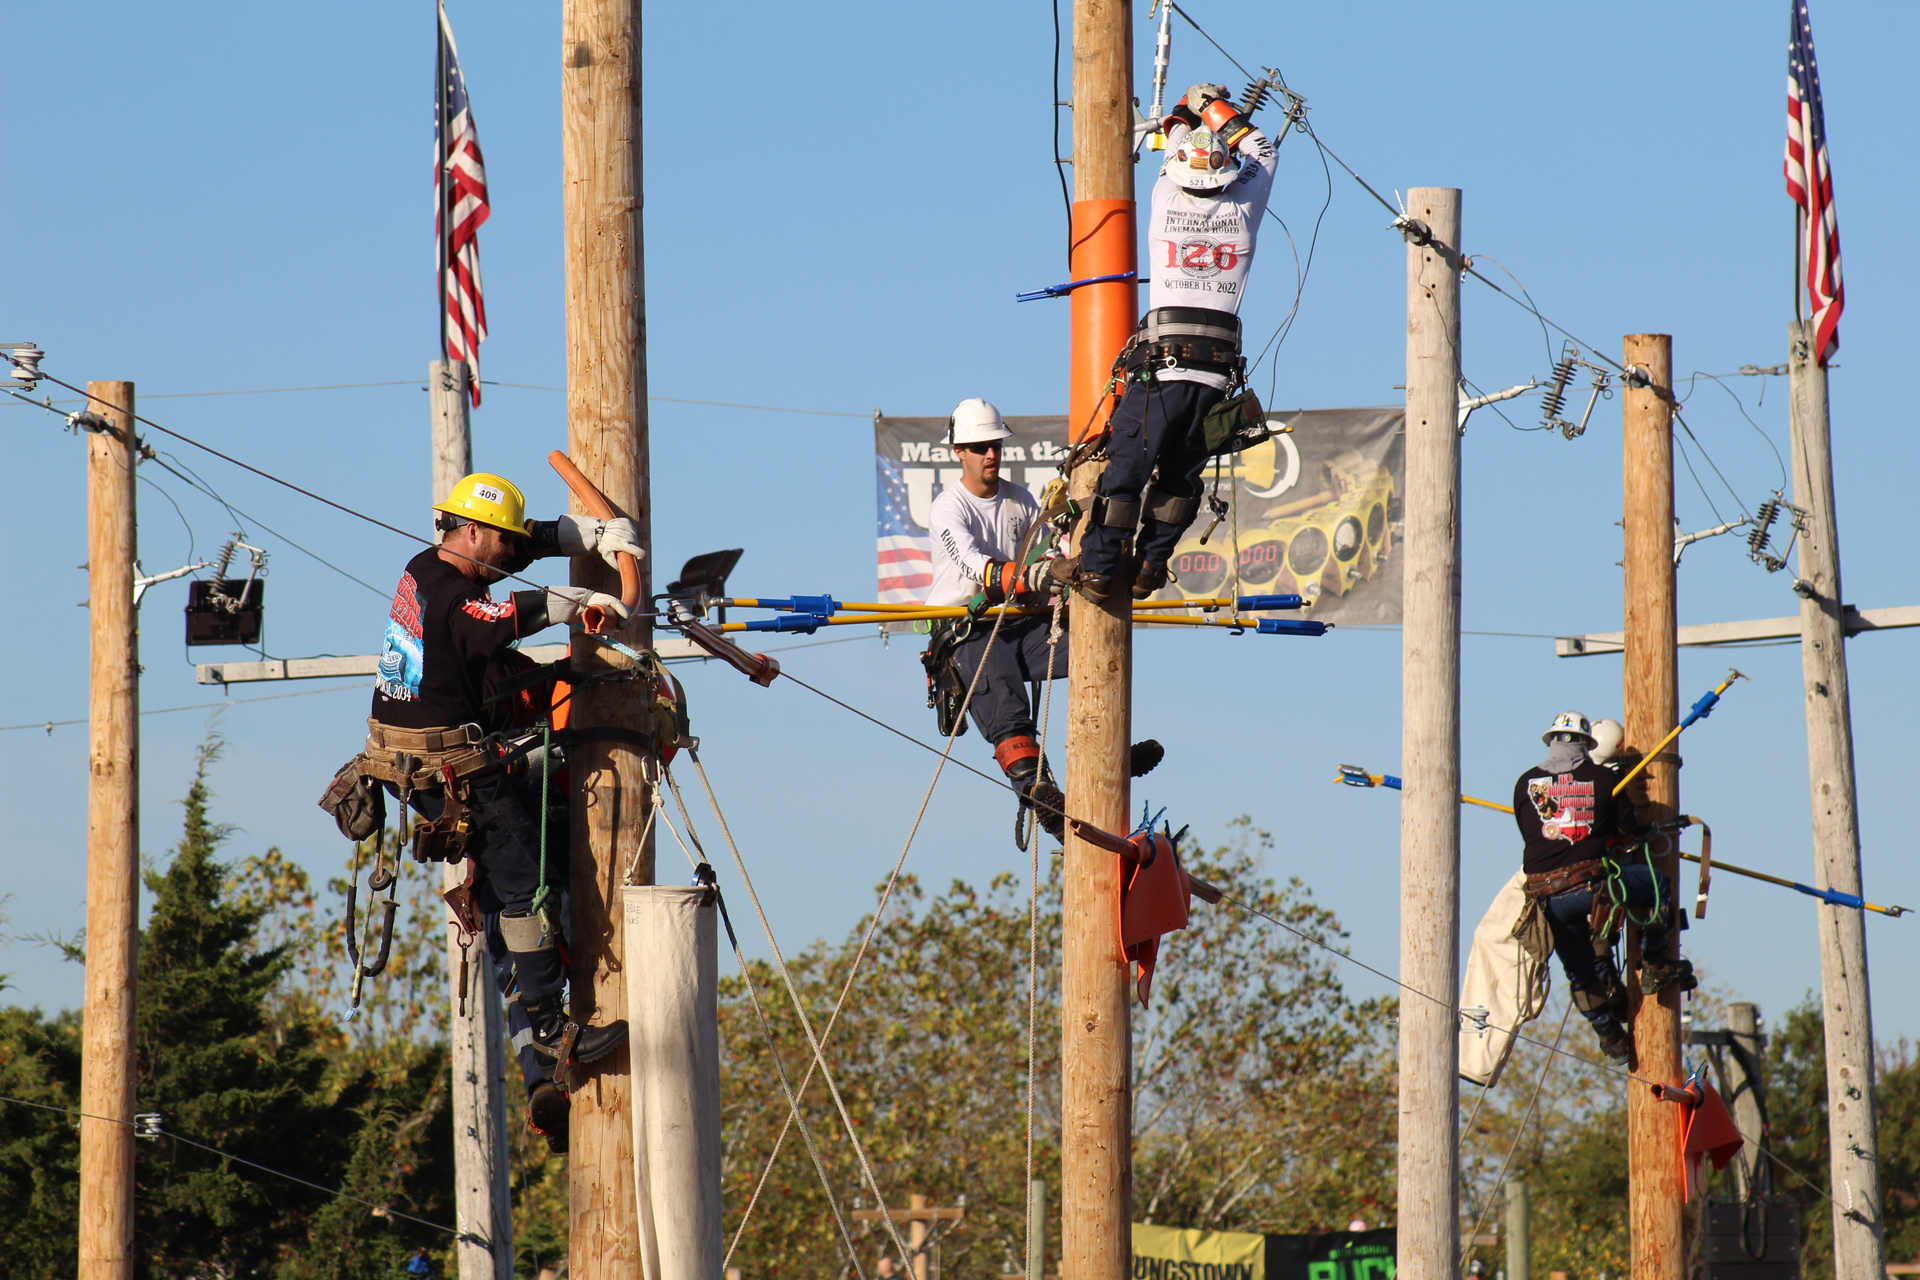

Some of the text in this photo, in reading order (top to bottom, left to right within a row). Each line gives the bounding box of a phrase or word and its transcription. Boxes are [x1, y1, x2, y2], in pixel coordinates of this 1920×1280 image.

[1166, 216, 1239, 227] INTERNATIONAL
[1163, 240, 1238, 270] 126
[1165, 279, 1199, 290] OCTOBER
[1217, 282, 1237, 294] 2022
[901, 442, 961, 462] Ma
[1030, 441, 1070, 461] th
[479, 490, 497, 501] 409
[392, 684, 411, 702] 2034
[1132, 1254, 1254, 1280] UNGSTOWN
